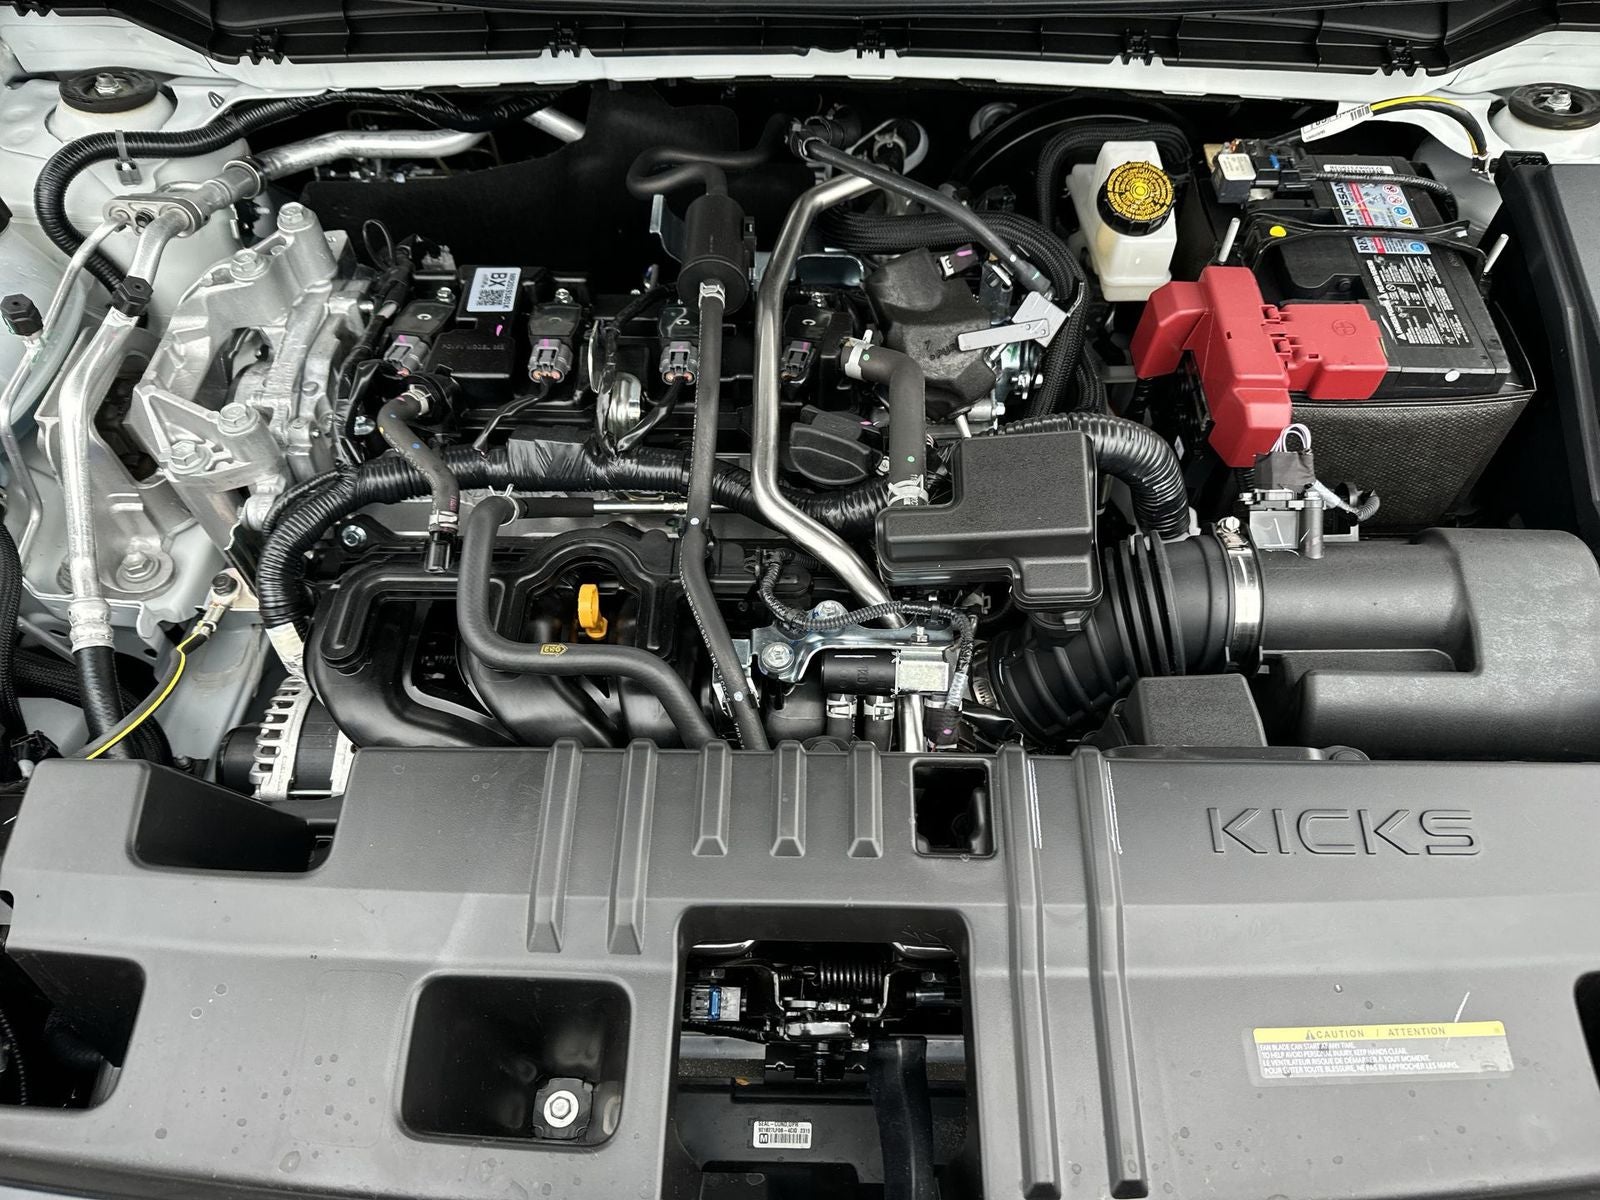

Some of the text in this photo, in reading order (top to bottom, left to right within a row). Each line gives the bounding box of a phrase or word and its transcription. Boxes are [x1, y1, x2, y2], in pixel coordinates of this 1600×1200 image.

[489, 273, 507, 287] BX
[1206, 807, 1481, 856] KICKS
[1316, 1029, 1364, 1039] CAUTION
[1388, 1026, 1446, 1037] ATTENTION
[1271, 1043, 1290, 1051] BLADE
[1262, 1051, 1270, 1059] TO
[1270, 1051, 1285, 1059] HELP
[1285, 1050, 1303, 1058] AVOID
[1384, 1055, 1400, 1063] TOUT
